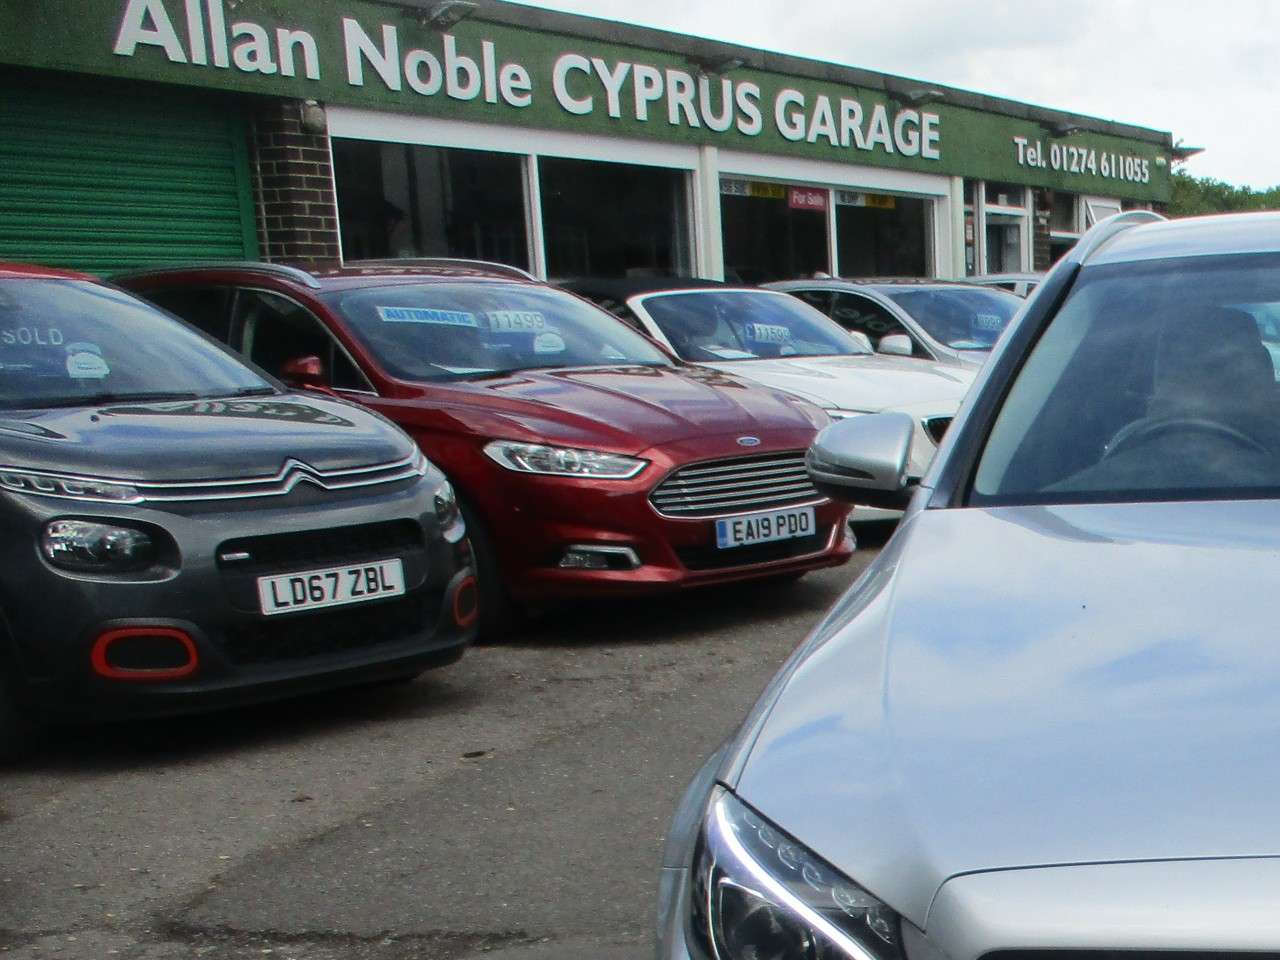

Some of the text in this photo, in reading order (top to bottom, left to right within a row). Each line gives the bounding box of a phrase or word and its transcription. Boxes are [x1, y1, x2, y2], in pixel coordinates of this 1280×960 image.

[113, 0, 941, 160] Allan Noble CYPRUS GARAGE
[1014, 136, 1149, 183] Tel. 01274 611055
[384, 307, 473, 325] AUTOMATIC
[2, 327, 64, 345] SOLD
[732, 512, 809, 542] EA19 PDO
[271, 565, 395, 608] LD67 ZBL
